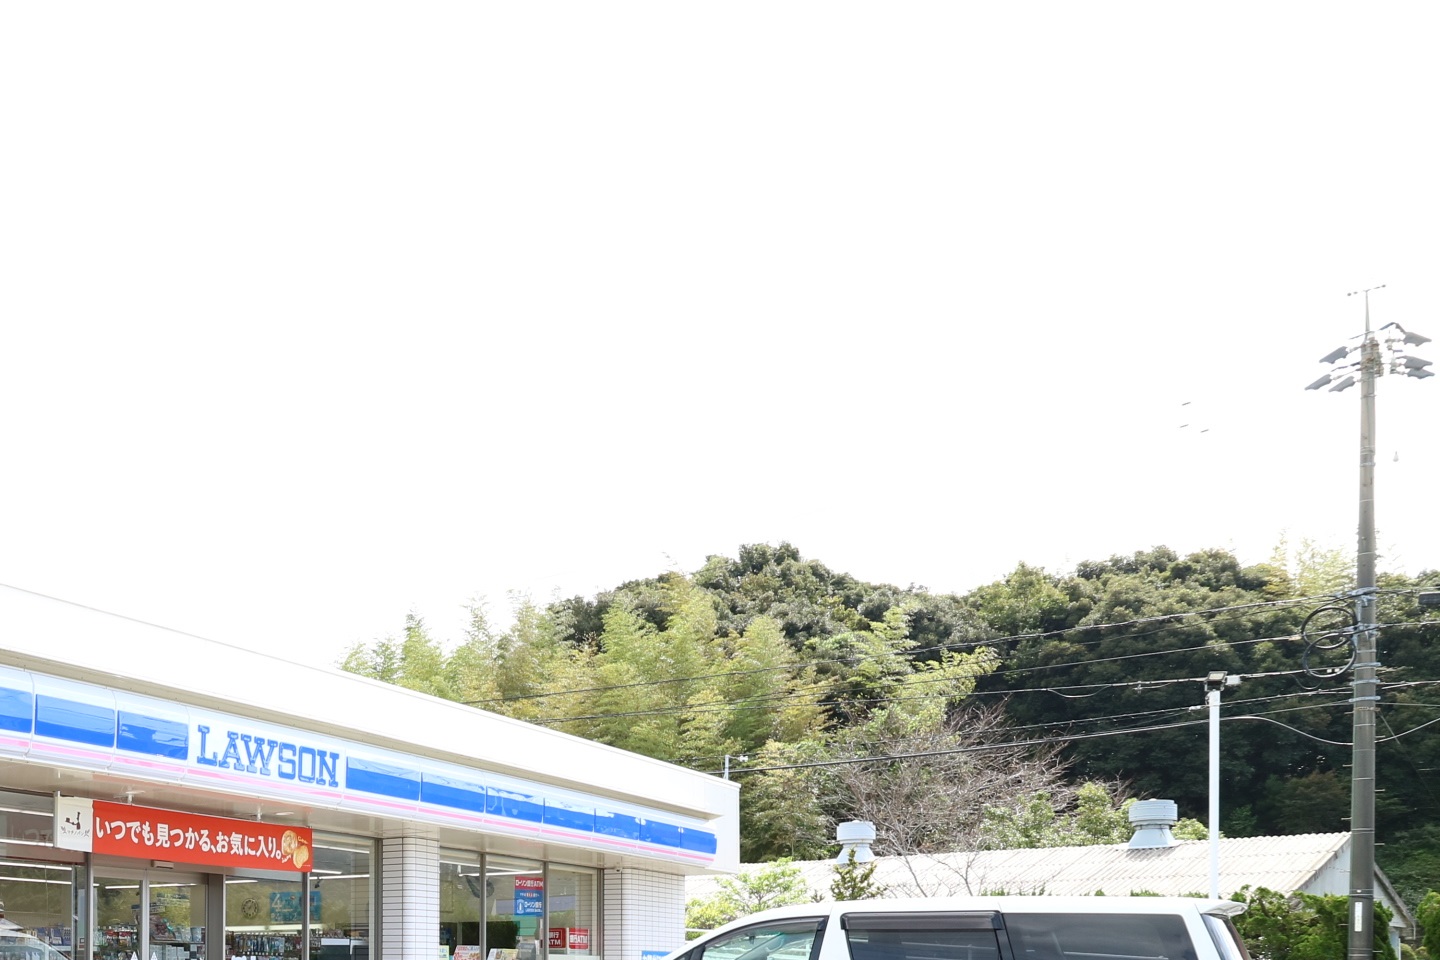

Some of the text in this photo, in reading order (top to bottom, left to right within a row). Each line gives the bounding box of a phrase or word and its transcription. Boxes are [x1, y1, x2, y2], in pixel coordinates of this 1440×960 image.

[197, 724, 339, 788] LAWSON
[95, 816, 282, 860] いつでも見つかる、お気に入り。
